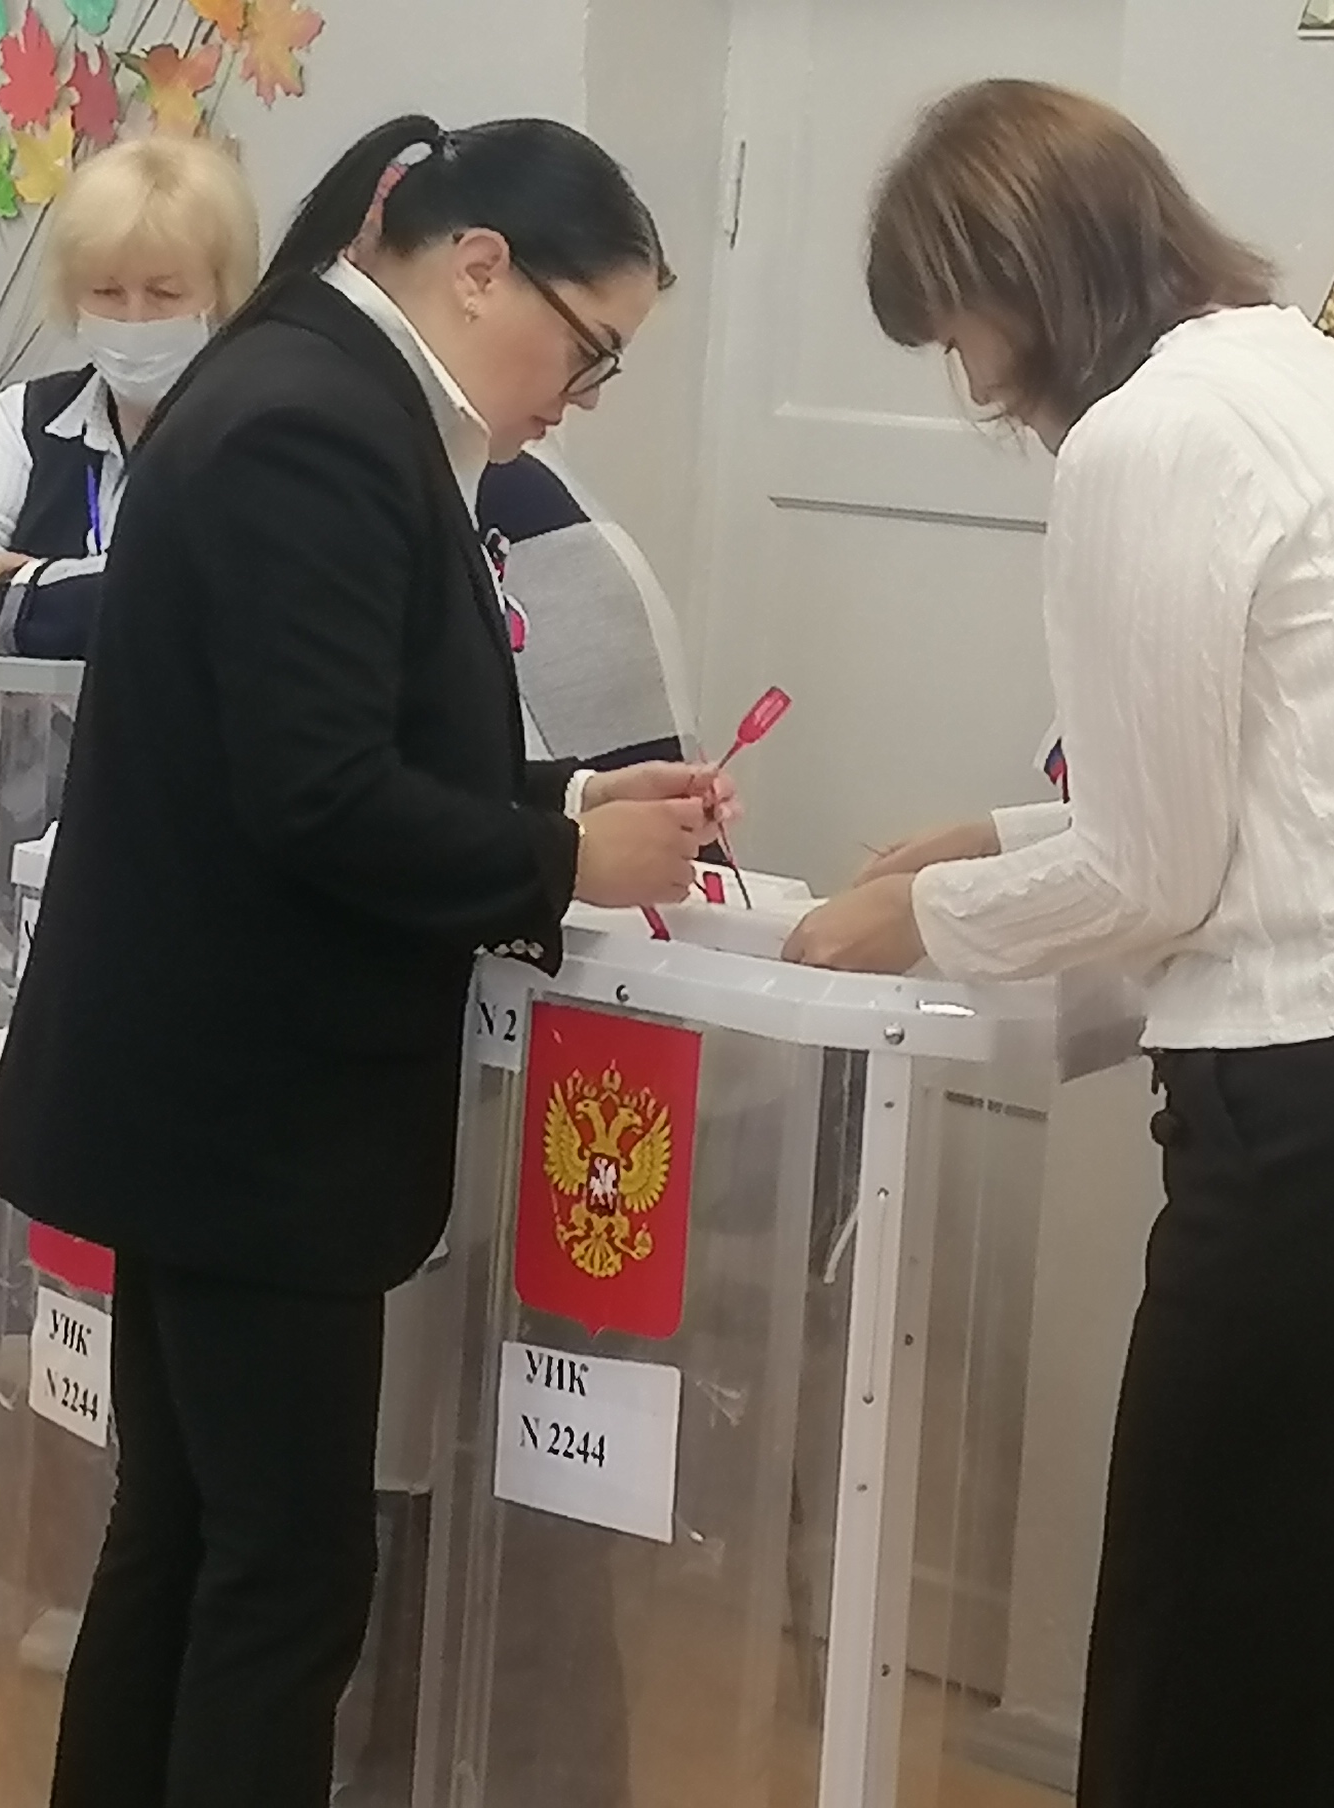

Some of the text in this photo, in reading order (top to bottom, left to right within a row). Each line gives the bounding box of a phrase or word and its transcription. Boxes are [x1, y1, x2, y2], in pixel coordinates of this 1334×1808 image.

[503, 1009, 517, 1043] 2
[49, 1308, 92, 1357] УИК
[525, 1349, 590, 1397] УИК
[61, 1376, 99, 1422] 2244
[519, 1413, 605, 1468] N 2244
